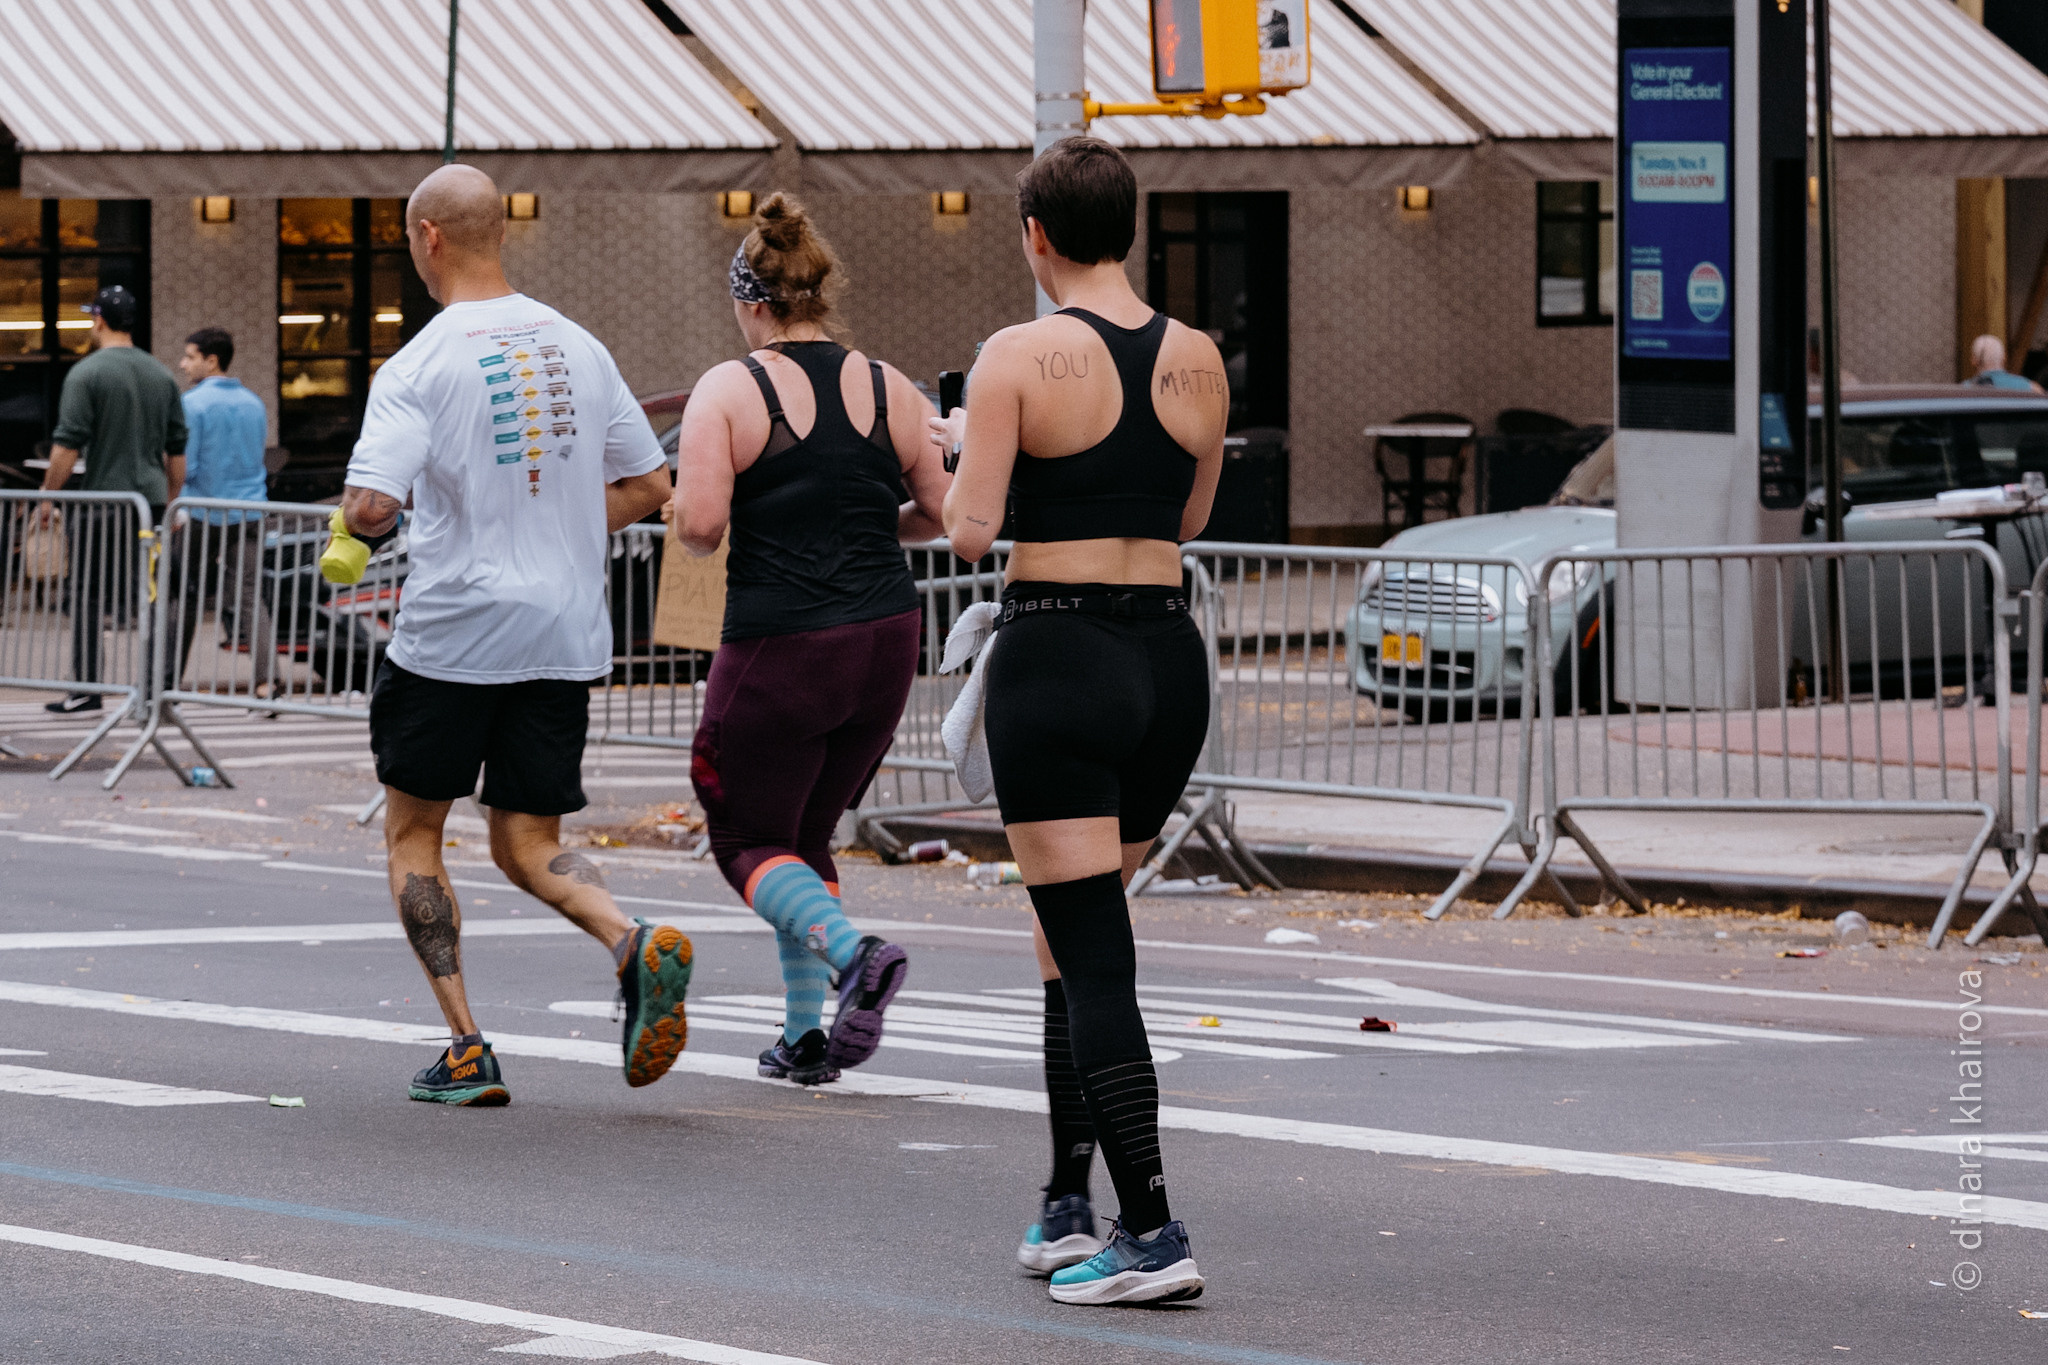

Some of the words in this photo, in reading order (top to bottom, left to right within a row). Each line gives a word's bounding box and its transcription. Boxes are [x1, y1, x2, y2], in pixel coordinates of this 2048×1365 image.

[1631, 63, 1655, 80] Vote
[1667, 66, 1692, 83] your
[1631, 82, 1673, 100] General
[1673, 82, 1722, 100] Election!
[466, 328, 502, 338] BARKLEY
[504, 325, 523, 333] FALL
[524, 319, 555, 330] CLASSIC
[1034, 351, 1089, 381] YOU
[451, 1063, 478, 1081] HOKA
